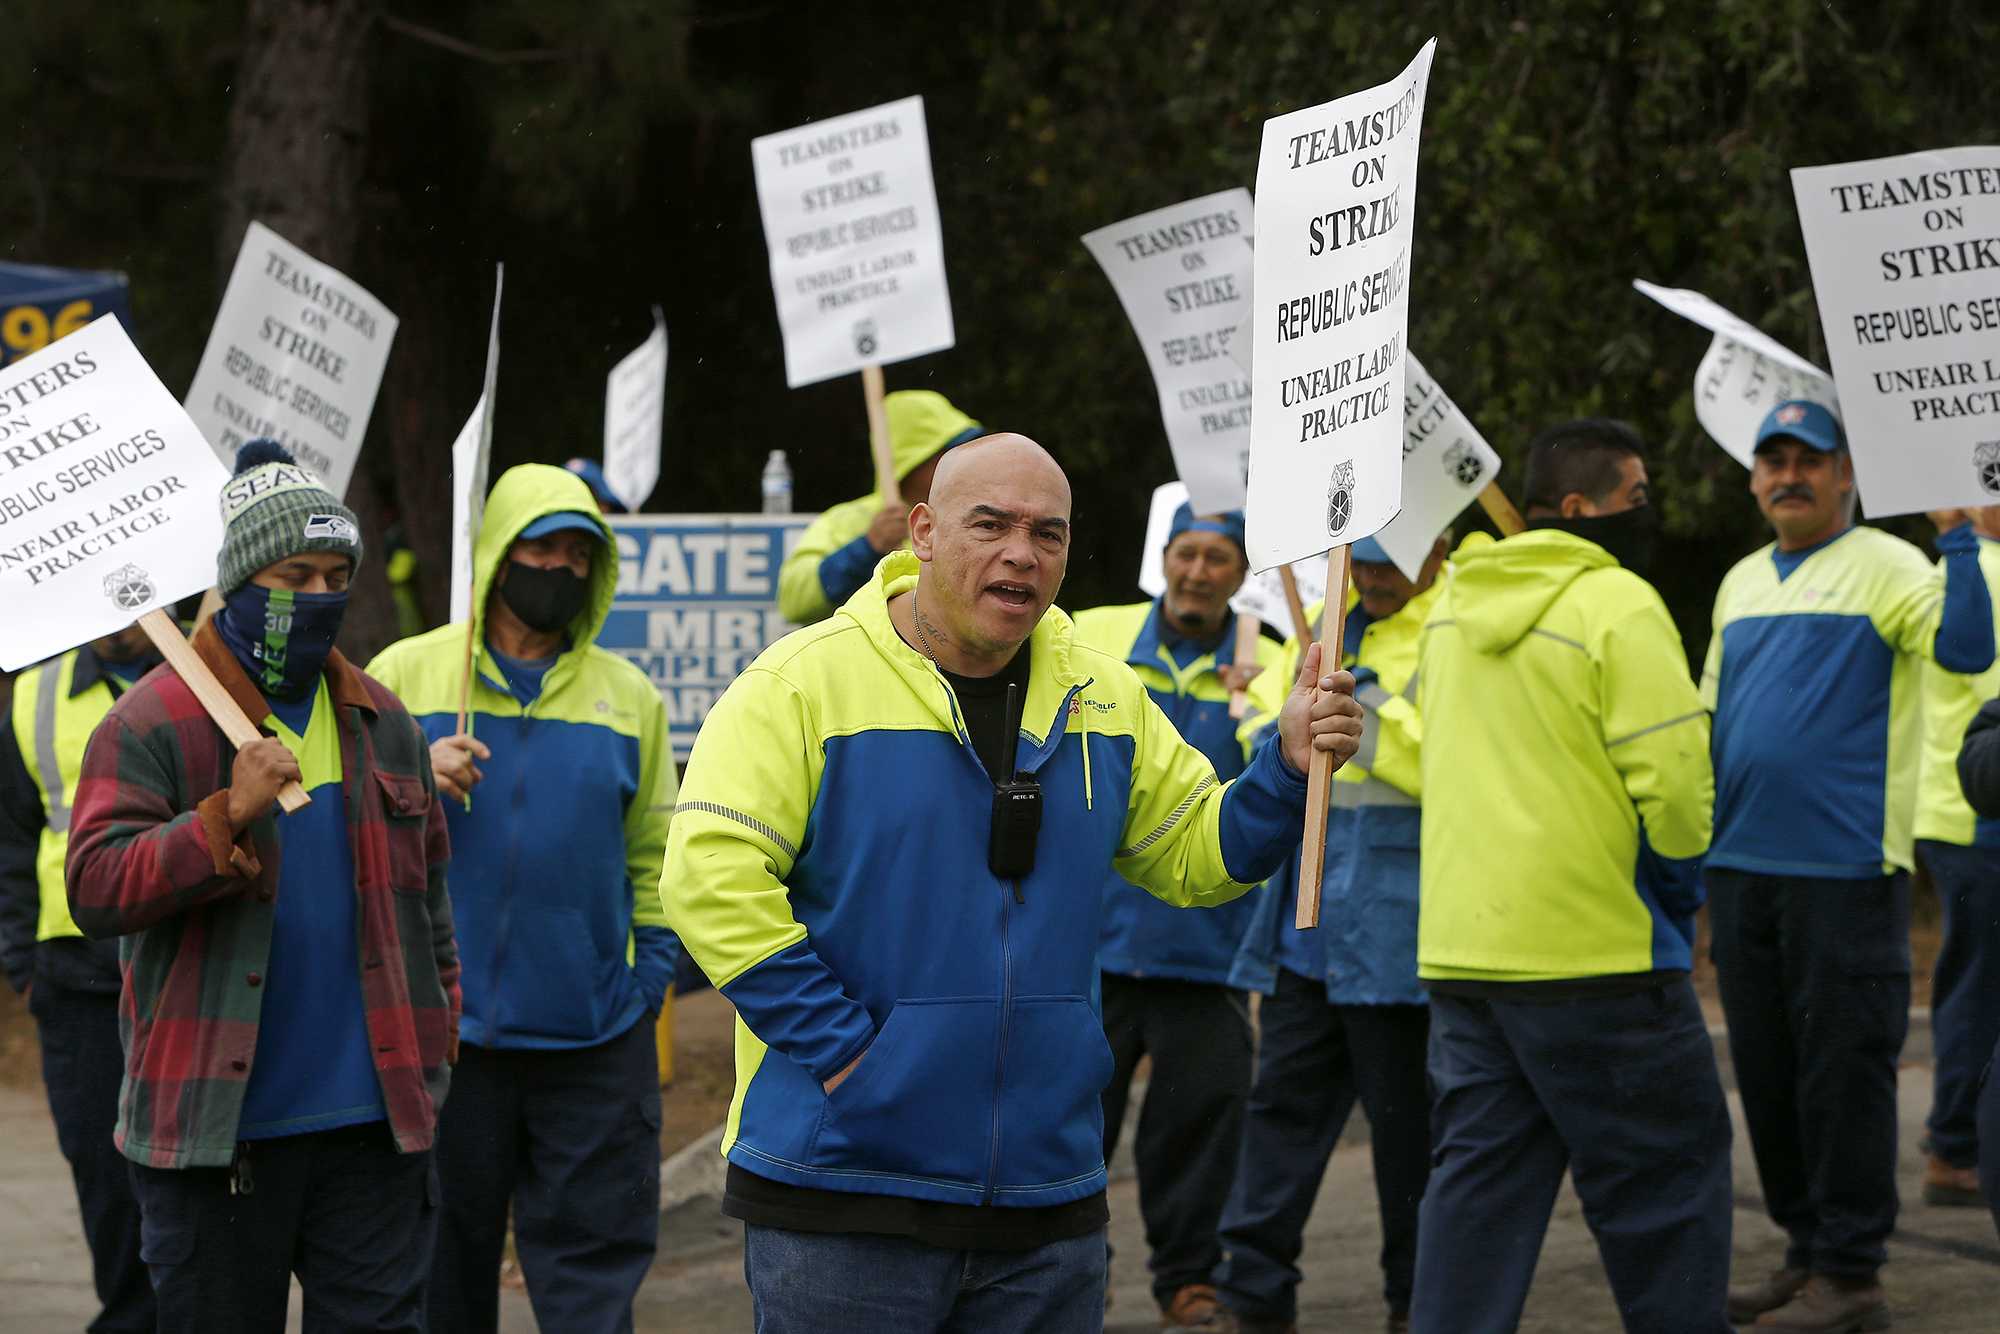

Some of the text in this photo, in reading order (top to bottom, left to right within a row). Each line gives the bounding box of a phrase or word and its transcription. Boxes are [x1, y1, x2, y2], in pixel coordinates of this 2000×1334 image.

[776, 117, 902, 168] TEAMSTERS
[1289, 80, 1417, 169] TEAMSTERS
[802, 171, 888, 214] STRIKE
[1352, 154, 1386, 188] ON
[1116, 210, 1241, 261] TEAMSTERS
[1309, 183, 1401, 256] STRIKE
[1924, 206, 1964, 232] ON
[1180, 252, 1206, 273] ON
[1880, 236, 2000, 282] STRIK
[265, 250, 377, 341] TEAMSTERS
[300, 307, 330, 334] ON
[1164, 274, 1241, 313] STRIKE
[1277, 280, 1357, 343] REPUBLIC
[1359, 246, 1406, 316] SERVICES
[1853, 303, 1962, 345] REPUBLIC
[0, 299, 93, 367] 96
[259, 315, 348, 384] STRIKE
[222, 345, 292, 402] REPUBLIC
[289, 384, 351, 441] SERVICES
[1281, 359, 1351, 408] UNFAIR
[1355, 330, 1401, 383] LABOR
[1872, 362, 1978, 394] UNFAIR
[1300, 380, 1391, 443] PRACTICE
[0, 412, 101, 475] RIKE
[55, 428, 166, 494] SERVICES
[0, 474, 188, 575] NFAIR LABOR
[24, 506, 171, 586] PRACTICE
[263, 611, 294, 635] 30
